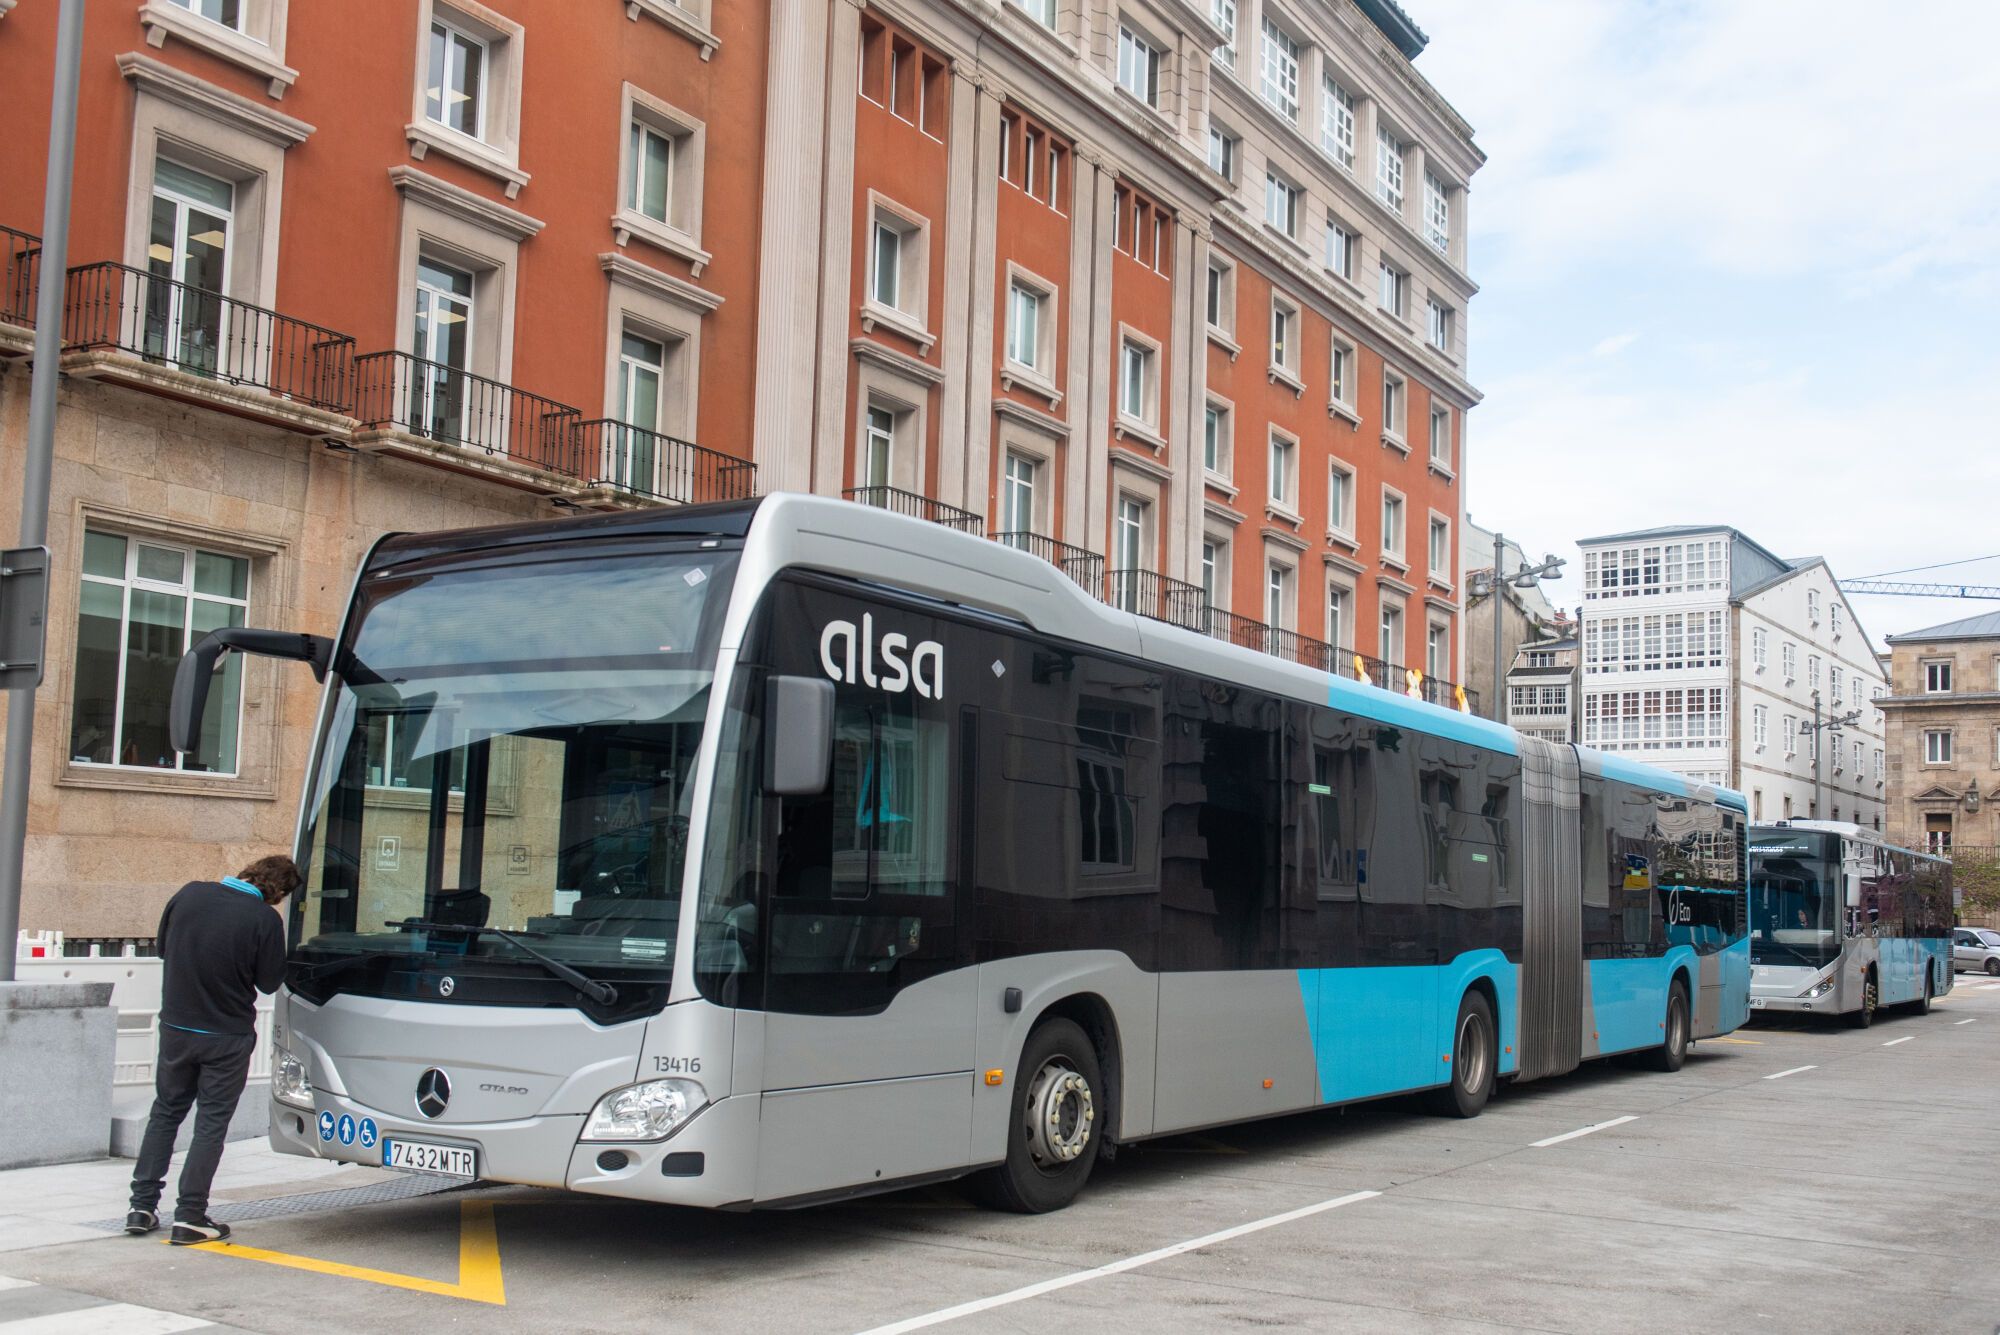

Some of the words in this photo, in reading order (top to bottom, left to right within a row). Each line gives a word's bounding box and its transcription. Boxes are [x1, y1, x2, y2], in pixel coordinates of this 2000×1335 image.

[820, 611, 943, 700] alsa
[1679, 902, 1691, 922] Eco
[653, 1056, 701, 1073] 13416
[479, 1083, 529, 1095] CITARO
[393, 1144, 472, 1174] 7432MTR
